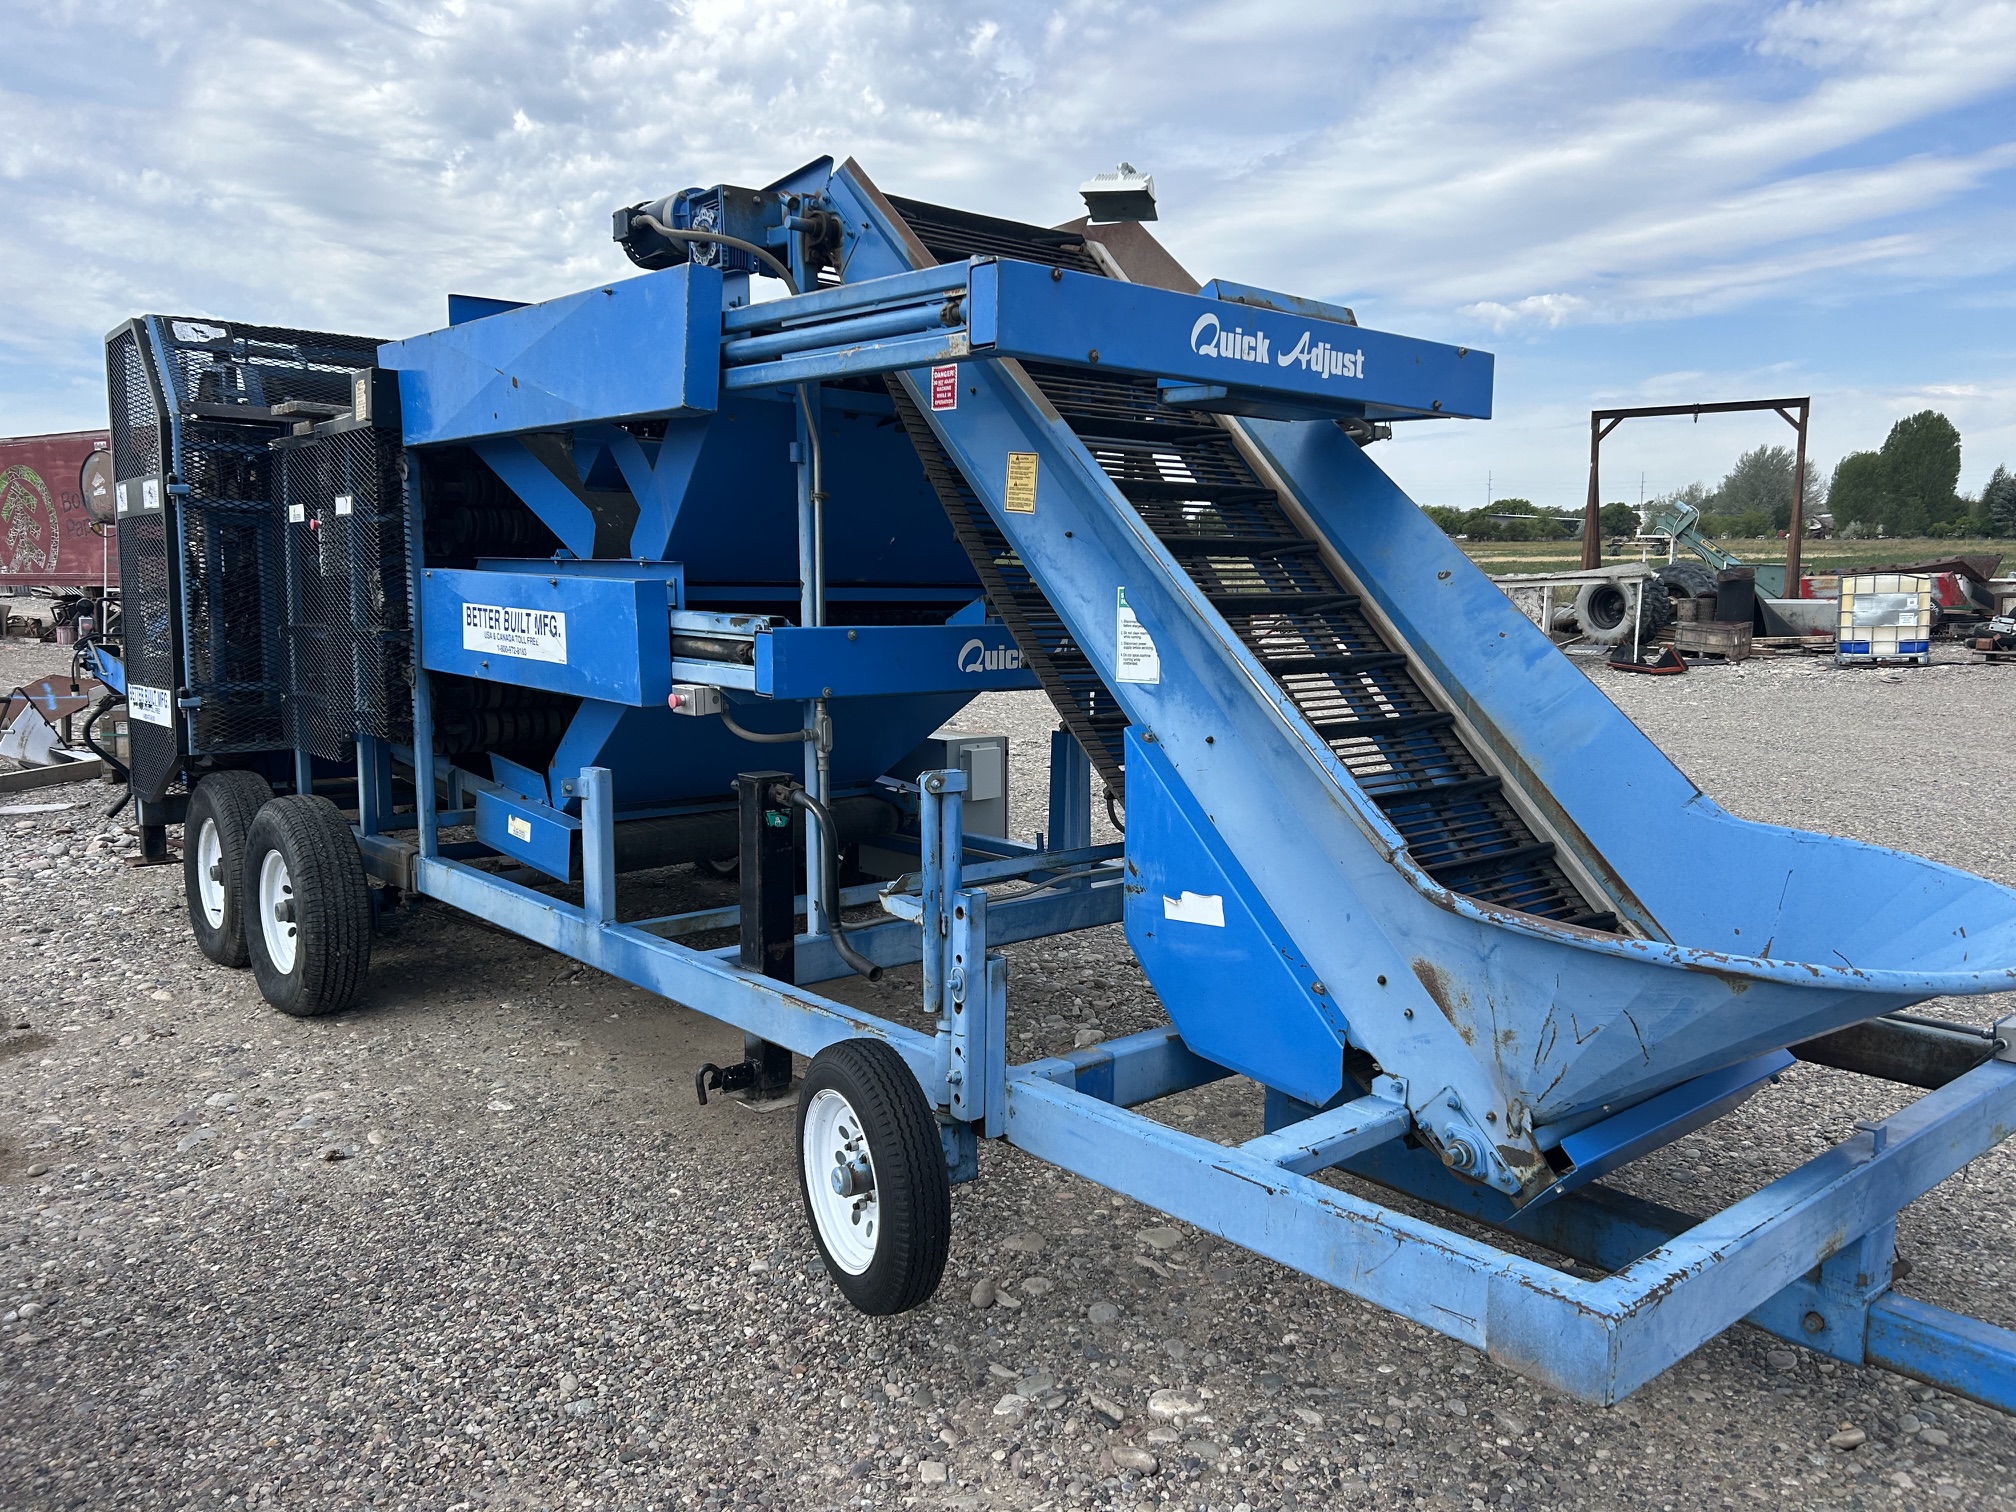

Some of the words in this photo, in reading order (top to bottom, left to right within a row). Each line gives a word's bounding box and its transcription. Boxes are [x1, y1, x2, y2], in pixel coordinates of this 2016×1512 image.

[1190, 312, 1270, 364] Quick
[1277, 331, 1365, 380] Adjust
[466, 606, 501, 631] BETTER
[503, 610, 532, 634] BUILT
[534, 613, 561, 638] MFG.
